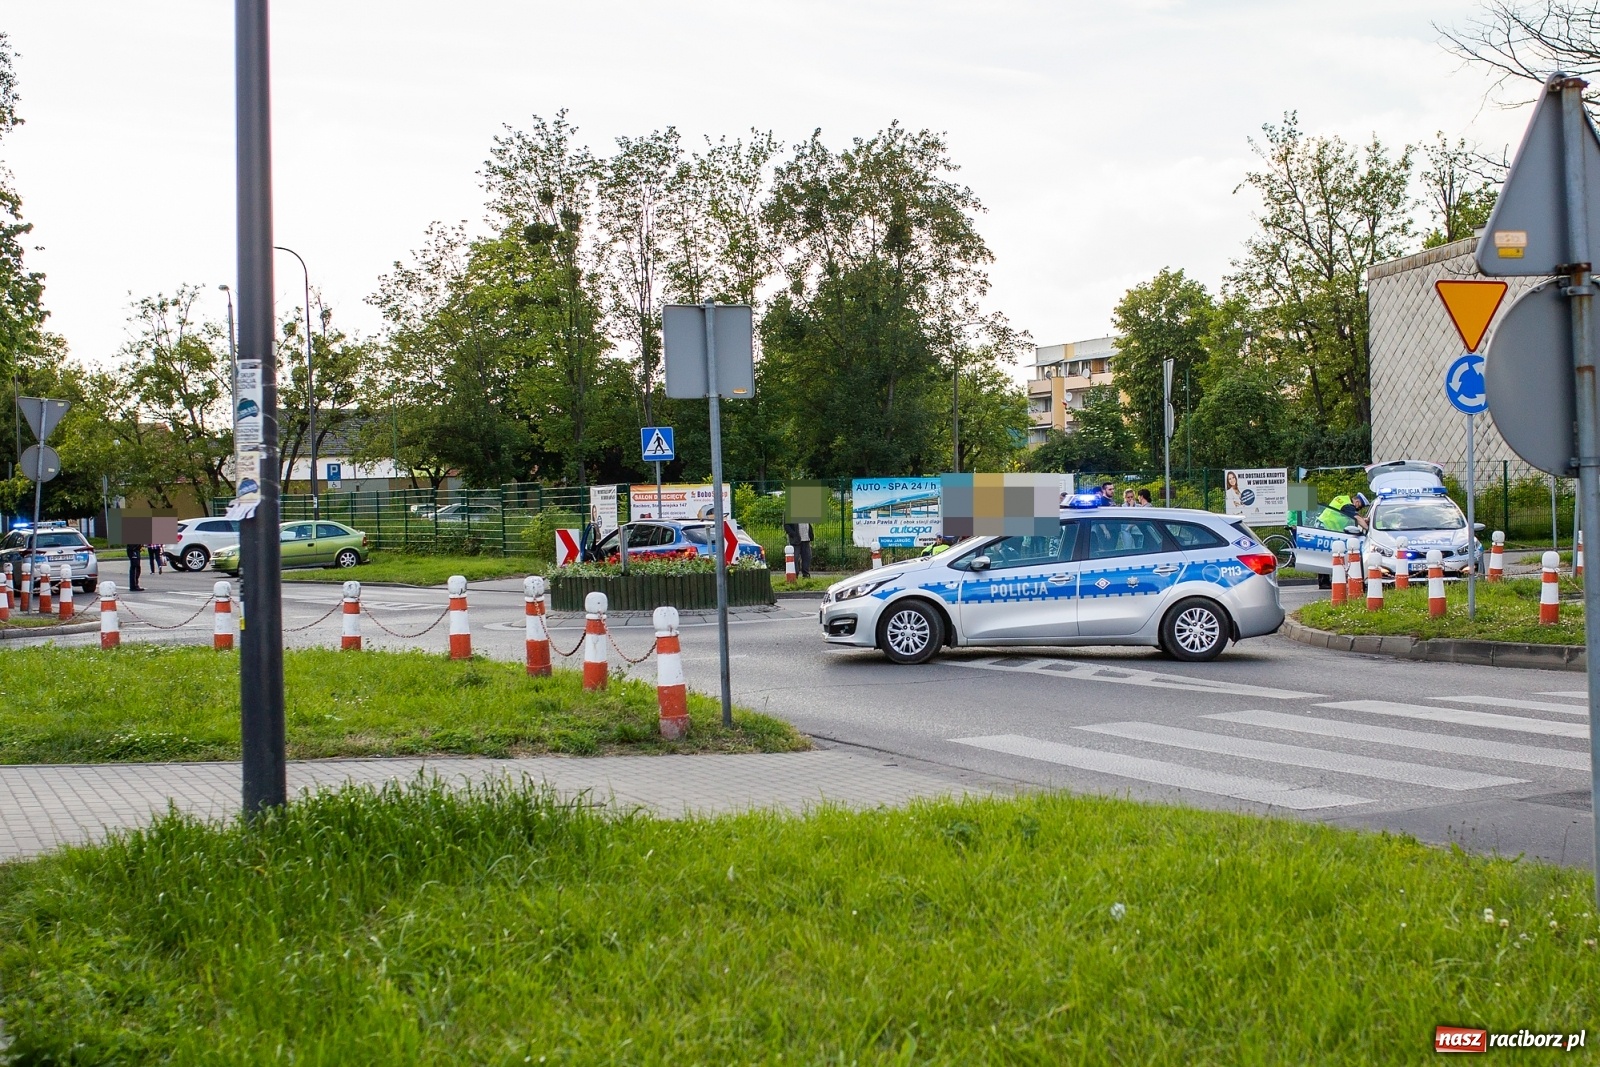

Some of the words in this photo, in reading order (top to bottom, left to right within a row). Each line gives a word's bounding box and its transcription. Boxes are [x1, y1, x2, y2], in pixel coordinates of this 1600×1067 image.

[856, 483, 881, 491] AUTO
[888, 482, 908, 490] SPA
[911, 482, 922, 490] 24
[654, 493, 684, 501] DIECIĘCY
[890, 525, 932, 535] autospa
[1220, 565, 1243, 578] P113
[990, 582, 1049, 598] POLICJA
